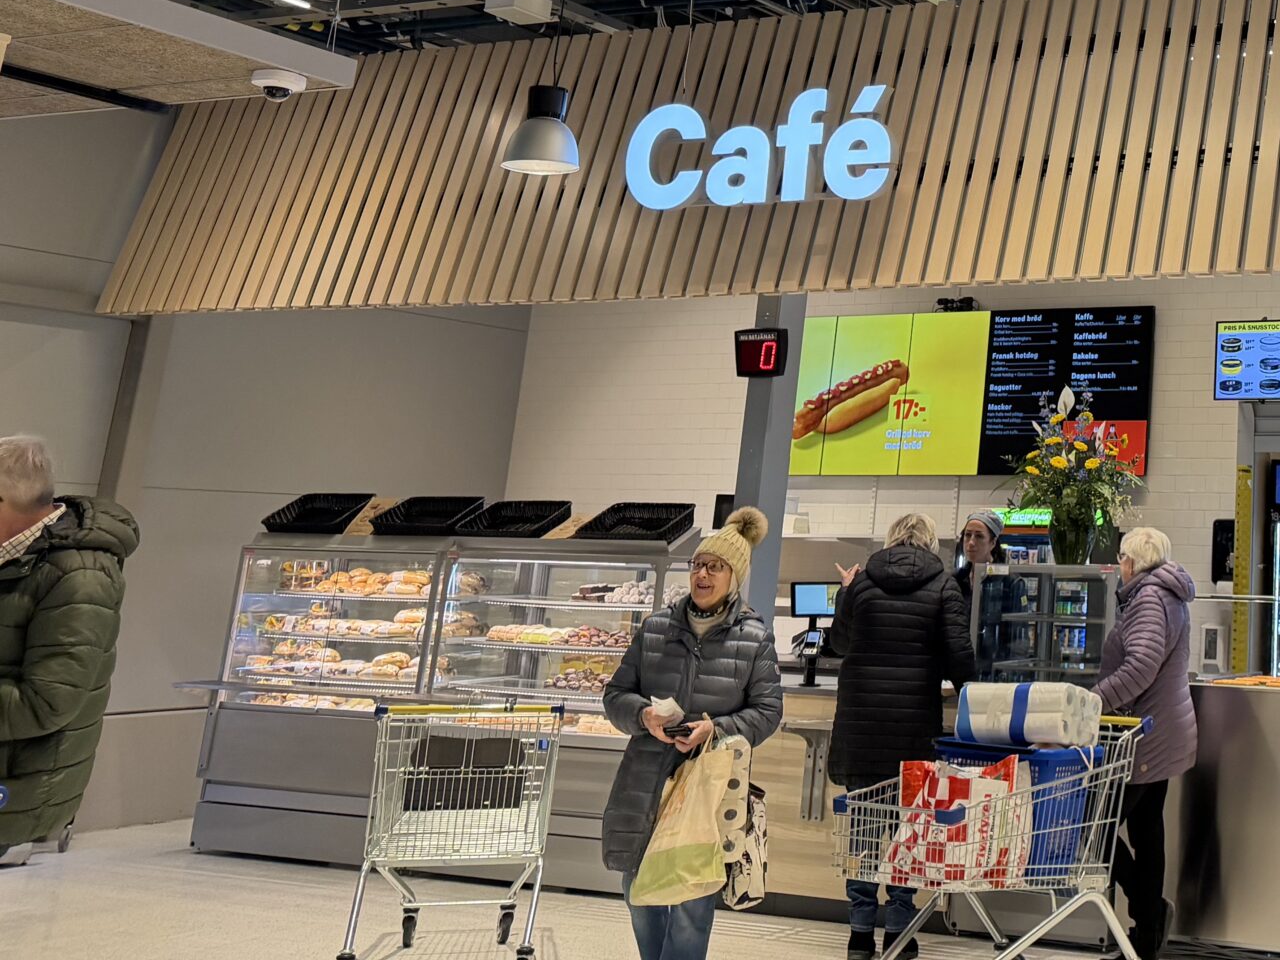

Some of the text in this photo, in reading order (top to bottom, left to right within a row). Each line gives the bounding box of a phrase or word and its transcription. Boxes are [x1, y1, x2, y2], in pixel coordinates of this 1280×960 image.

[625, 85, 891, 210] Café
[1074, 332, 1108, 340] Kaffebröd
[760, 342, 776, 369] 0
[1097, 371, 1116, 379] lunch
